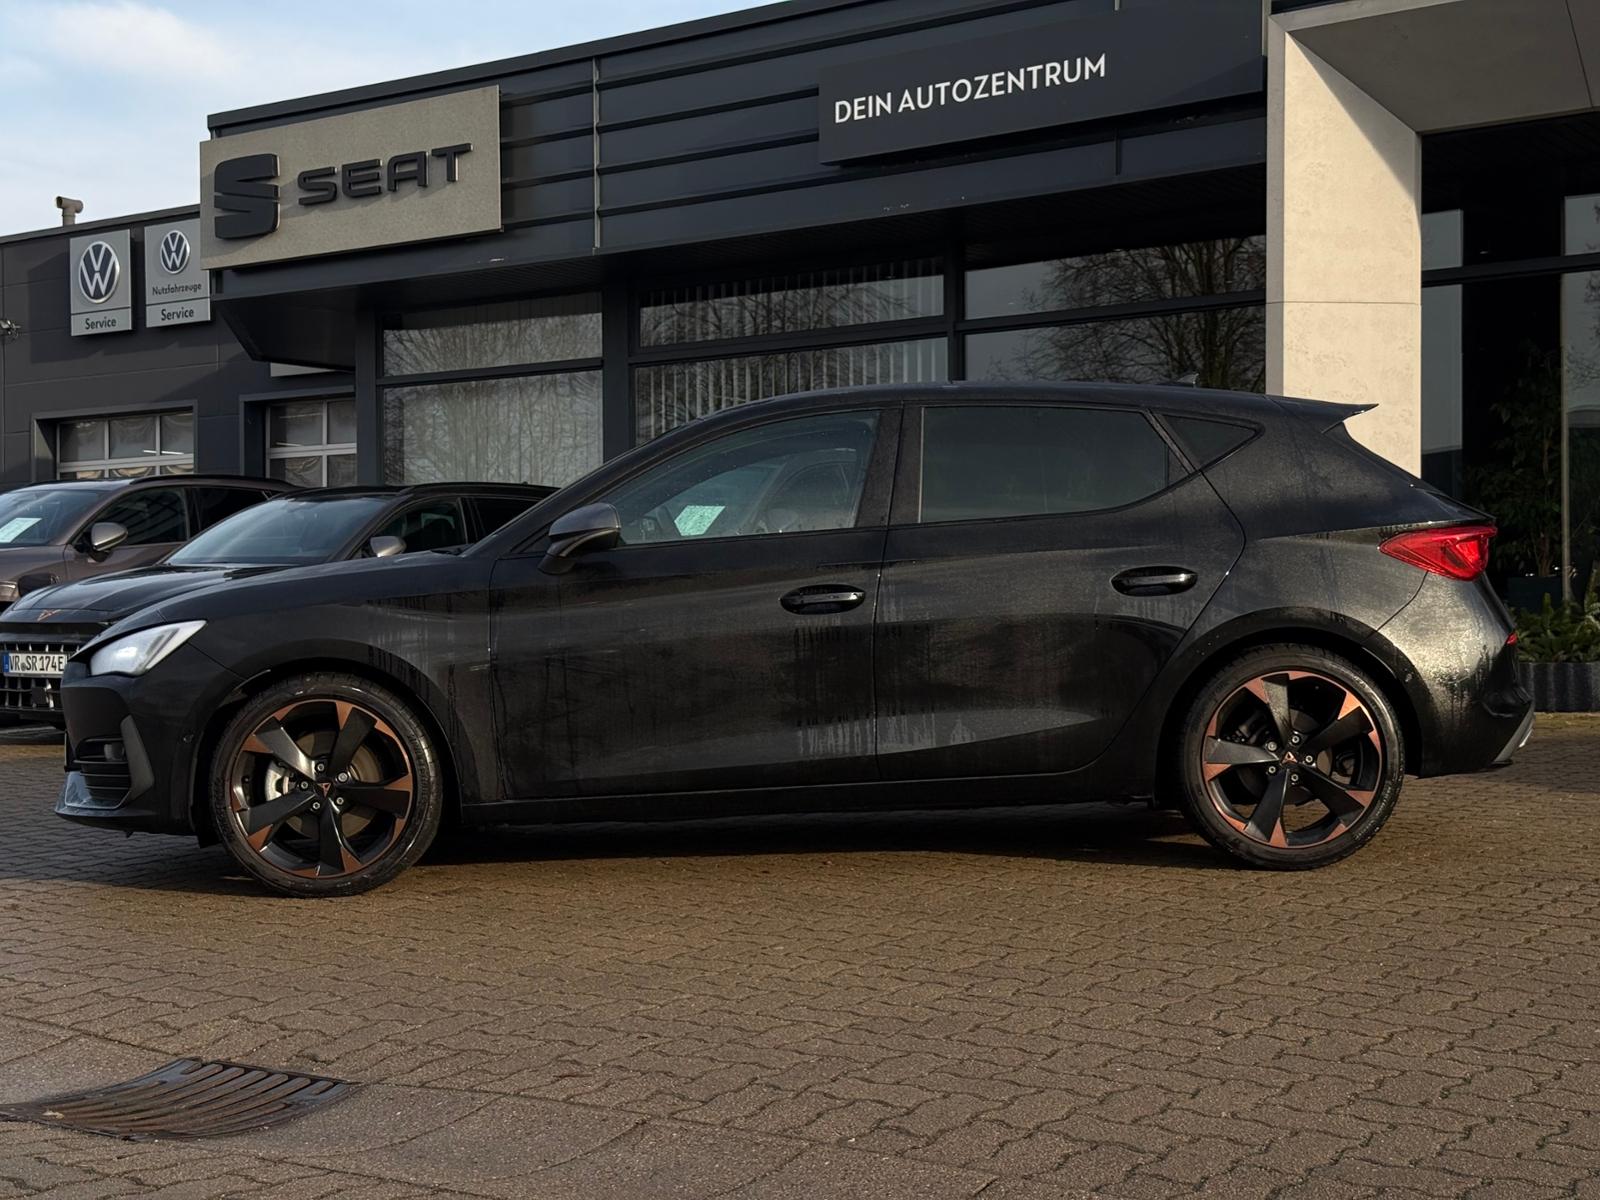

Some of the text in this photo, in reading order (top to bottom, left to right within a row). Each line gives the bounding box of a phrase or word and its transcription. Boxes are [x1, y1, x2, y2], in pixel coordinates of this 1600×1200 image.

[834, 52, 1106, 124] DEIN AUTOZENTRUM
[297, 142, 473, 206] SEAT
[152, 282, 202, 296] Nutzfahrzeuge
[160, 306, 195, 322] Service
[84, 315, 117, 331] Service
